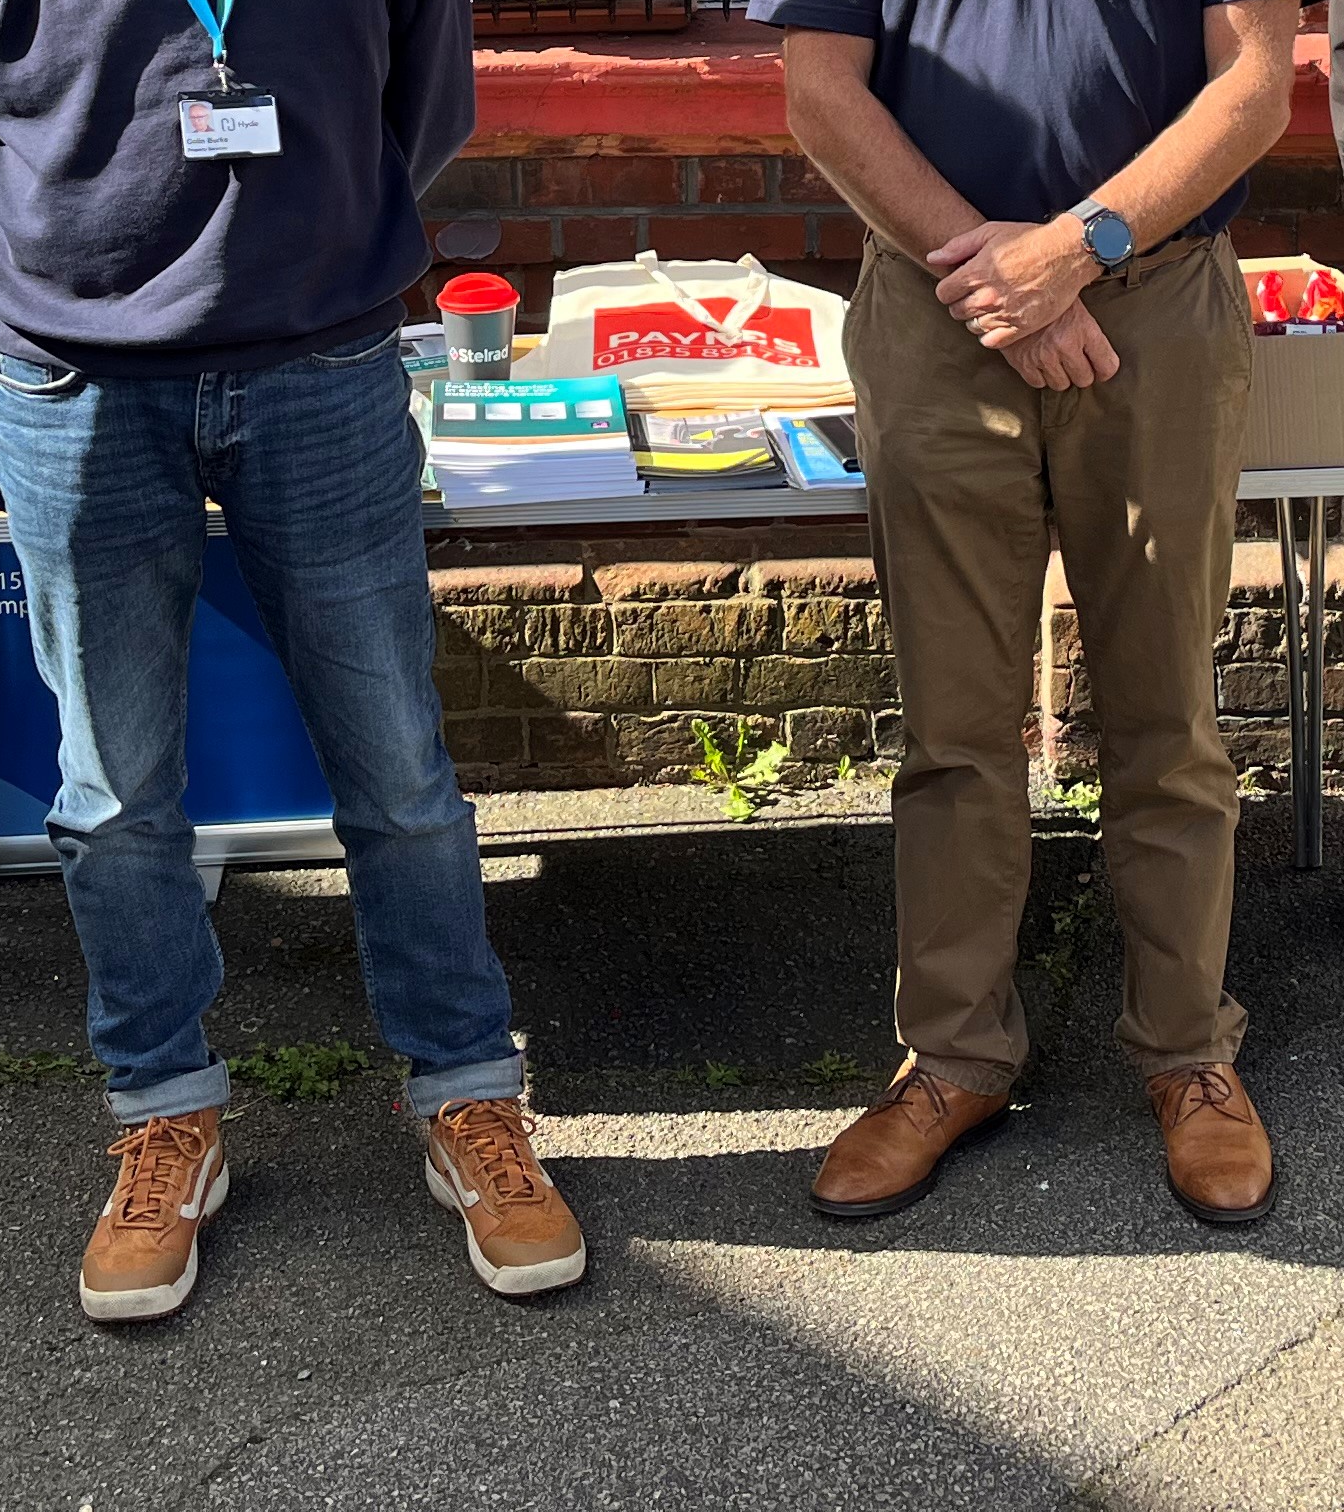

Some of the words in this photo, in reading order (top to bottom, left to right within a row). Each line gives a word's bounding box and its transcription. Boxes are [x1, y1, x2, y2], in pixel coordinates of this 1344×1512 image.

[459, 344, 509, 363] Stelrad
[596, 347, 690, 368] 01825
[701, 344, 815, 368] 891720
